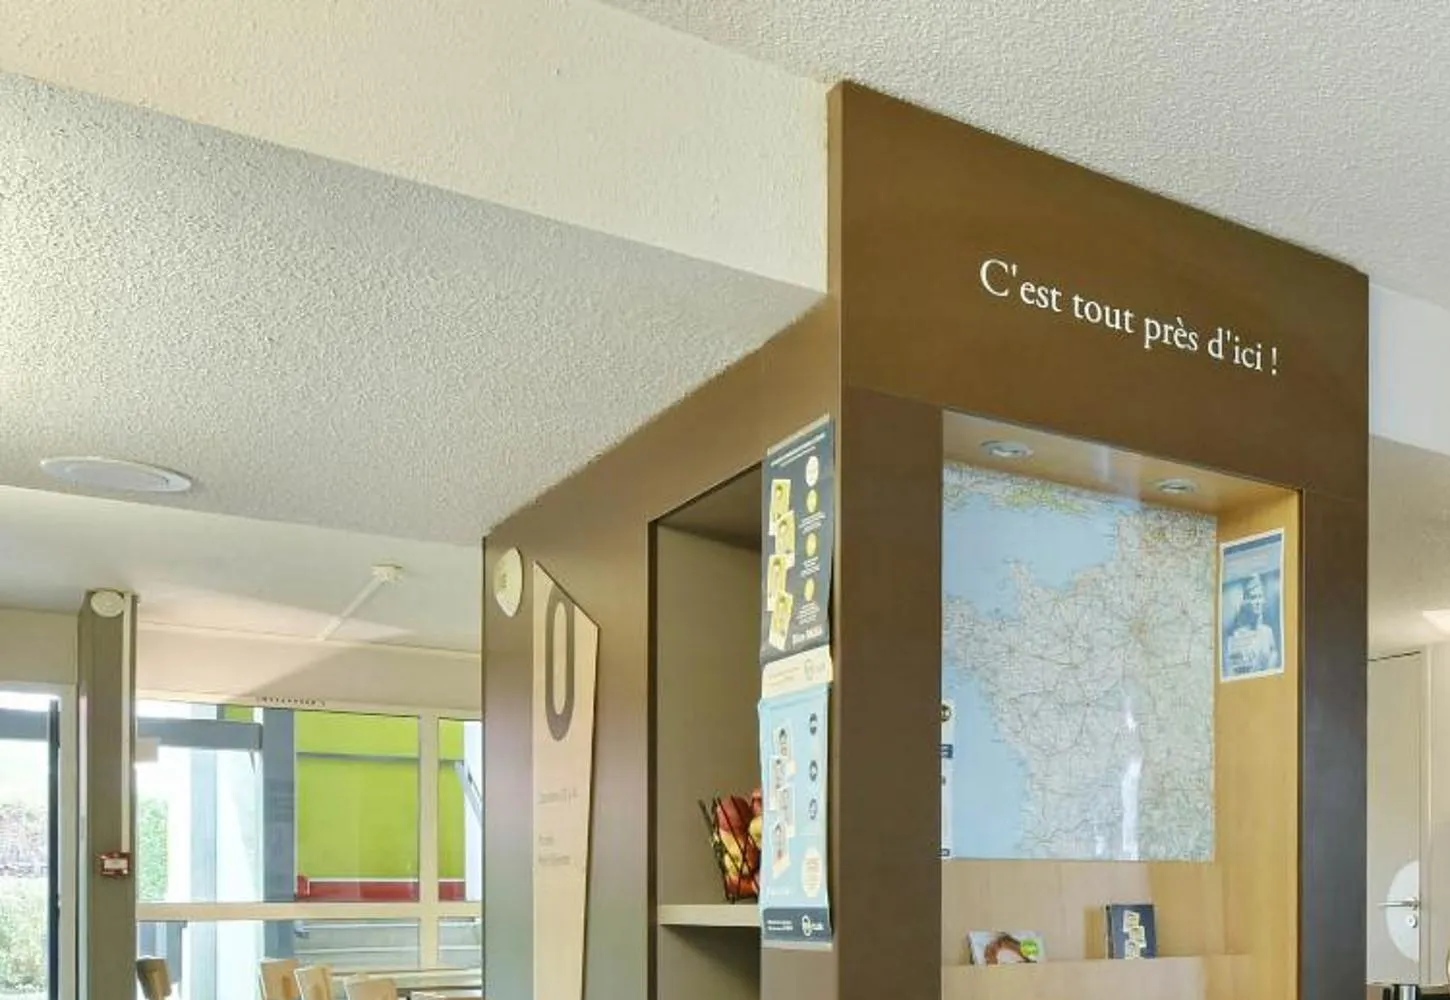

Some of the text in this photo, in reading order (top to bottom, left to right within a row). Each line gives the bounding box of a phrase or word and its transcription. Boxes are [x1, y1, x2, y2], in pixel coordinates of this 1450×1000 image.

[979, 258, 1062, 312] C'est
[1072, 294, 1135, 333] tout
[1143, 316, 1199, 351] près
[1207, 327, 1264, 371] d'ici
